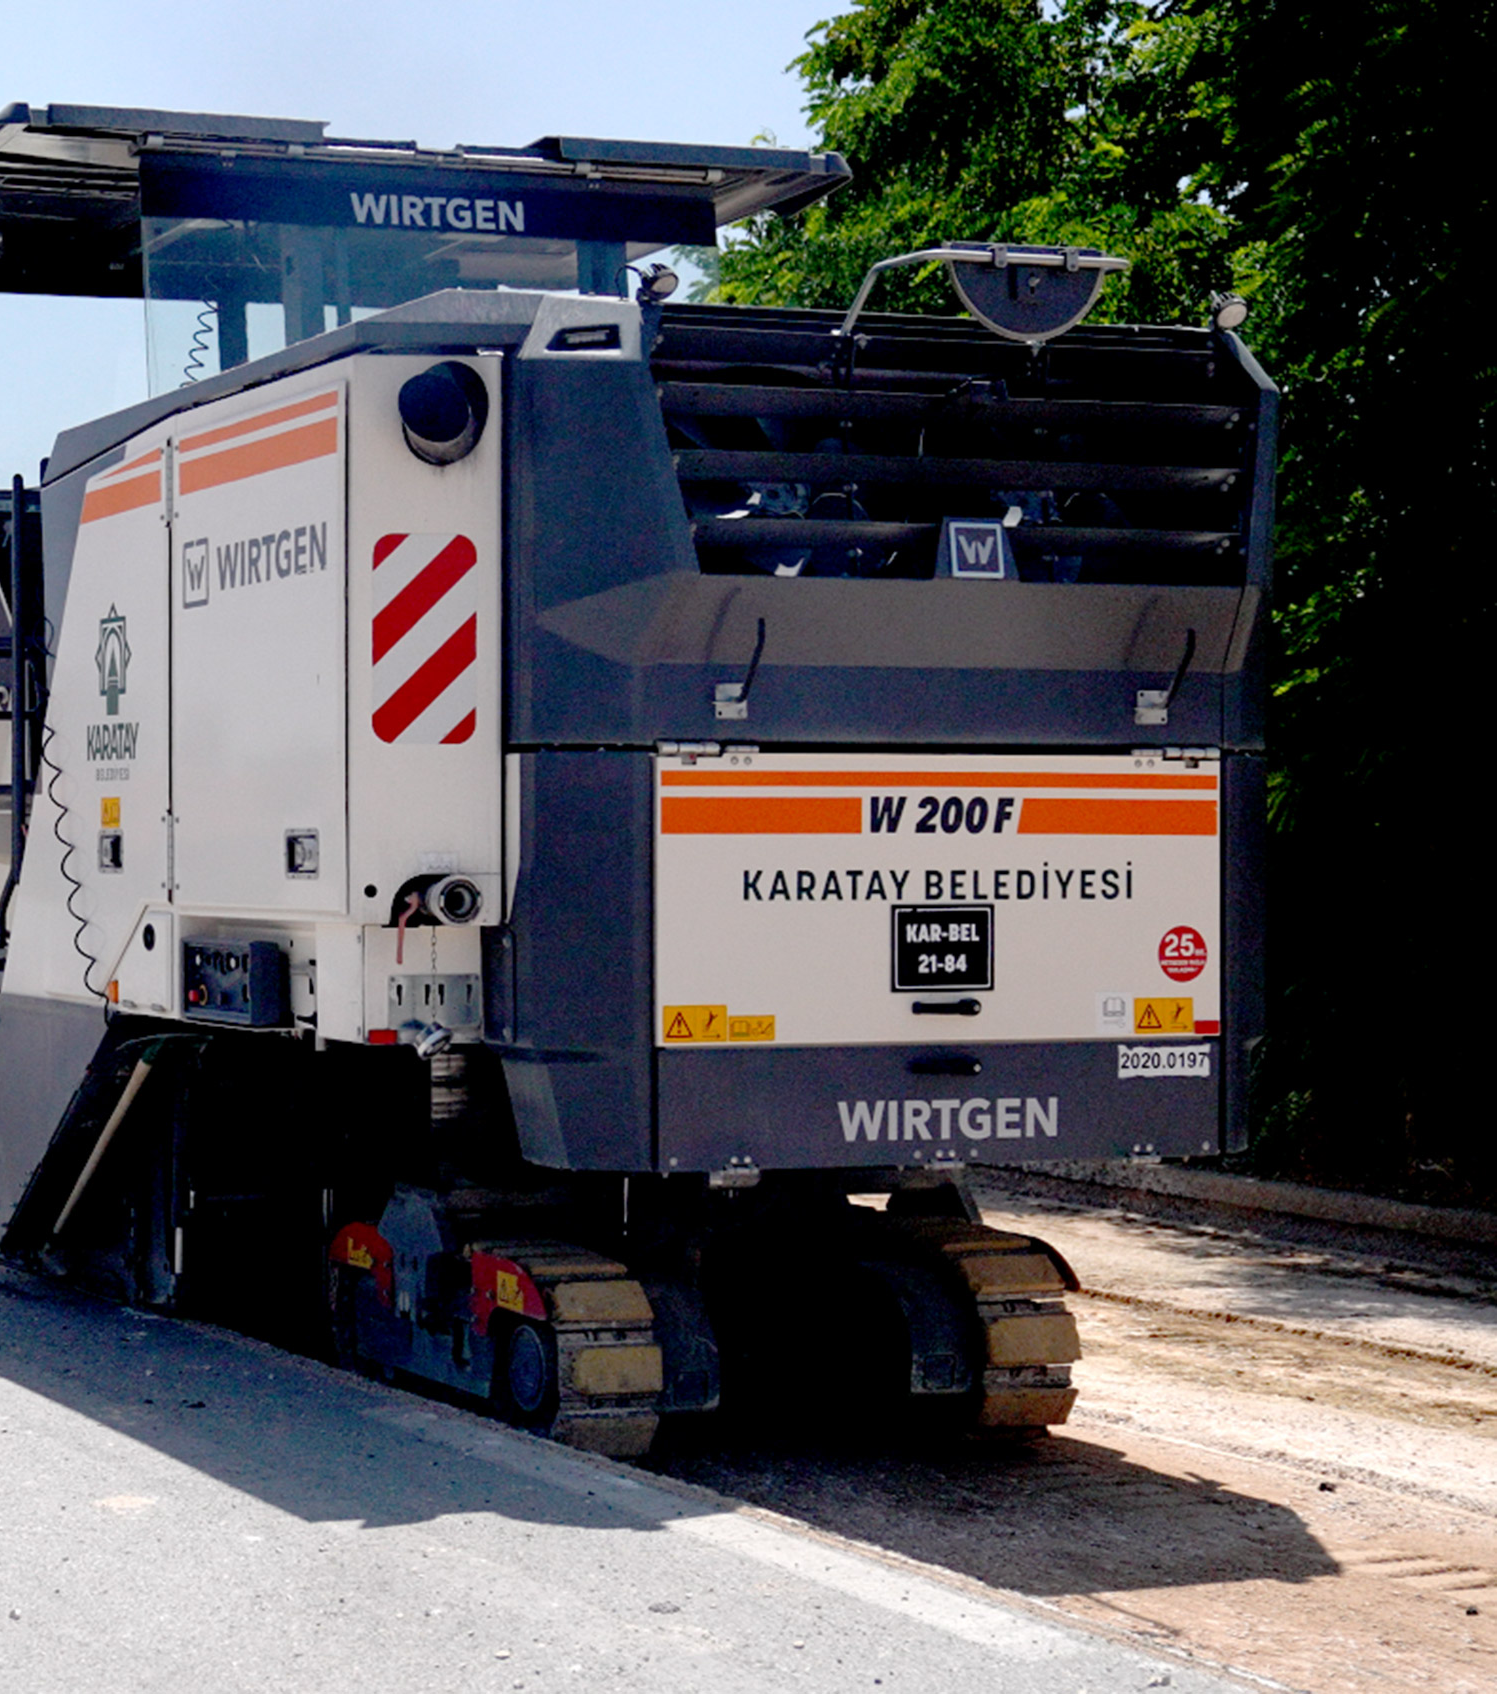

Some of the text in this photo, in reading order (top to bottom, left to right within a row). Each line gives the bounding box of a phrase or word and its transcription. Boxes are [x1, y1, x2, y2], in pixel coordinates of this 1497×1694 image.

[349, 192, 525, 232] WIRTGEN
[216, 521, 327, 591] WIRTGEN
[86, 722, 140, 761] KARATAY
[870, 796, 907, 834] W
[743, 861, 1134, 901] KARATAY BELEDİYESİ
[905, 923, 980, 943] KAR-BEL
[1164, 933, 1195, 957] 25
[918, 953, 968, 974] 21-84
[1120, 1051, 1208, 1070] 2020.0197
[838, 1096, 1059, 1143] WIRTGEN
